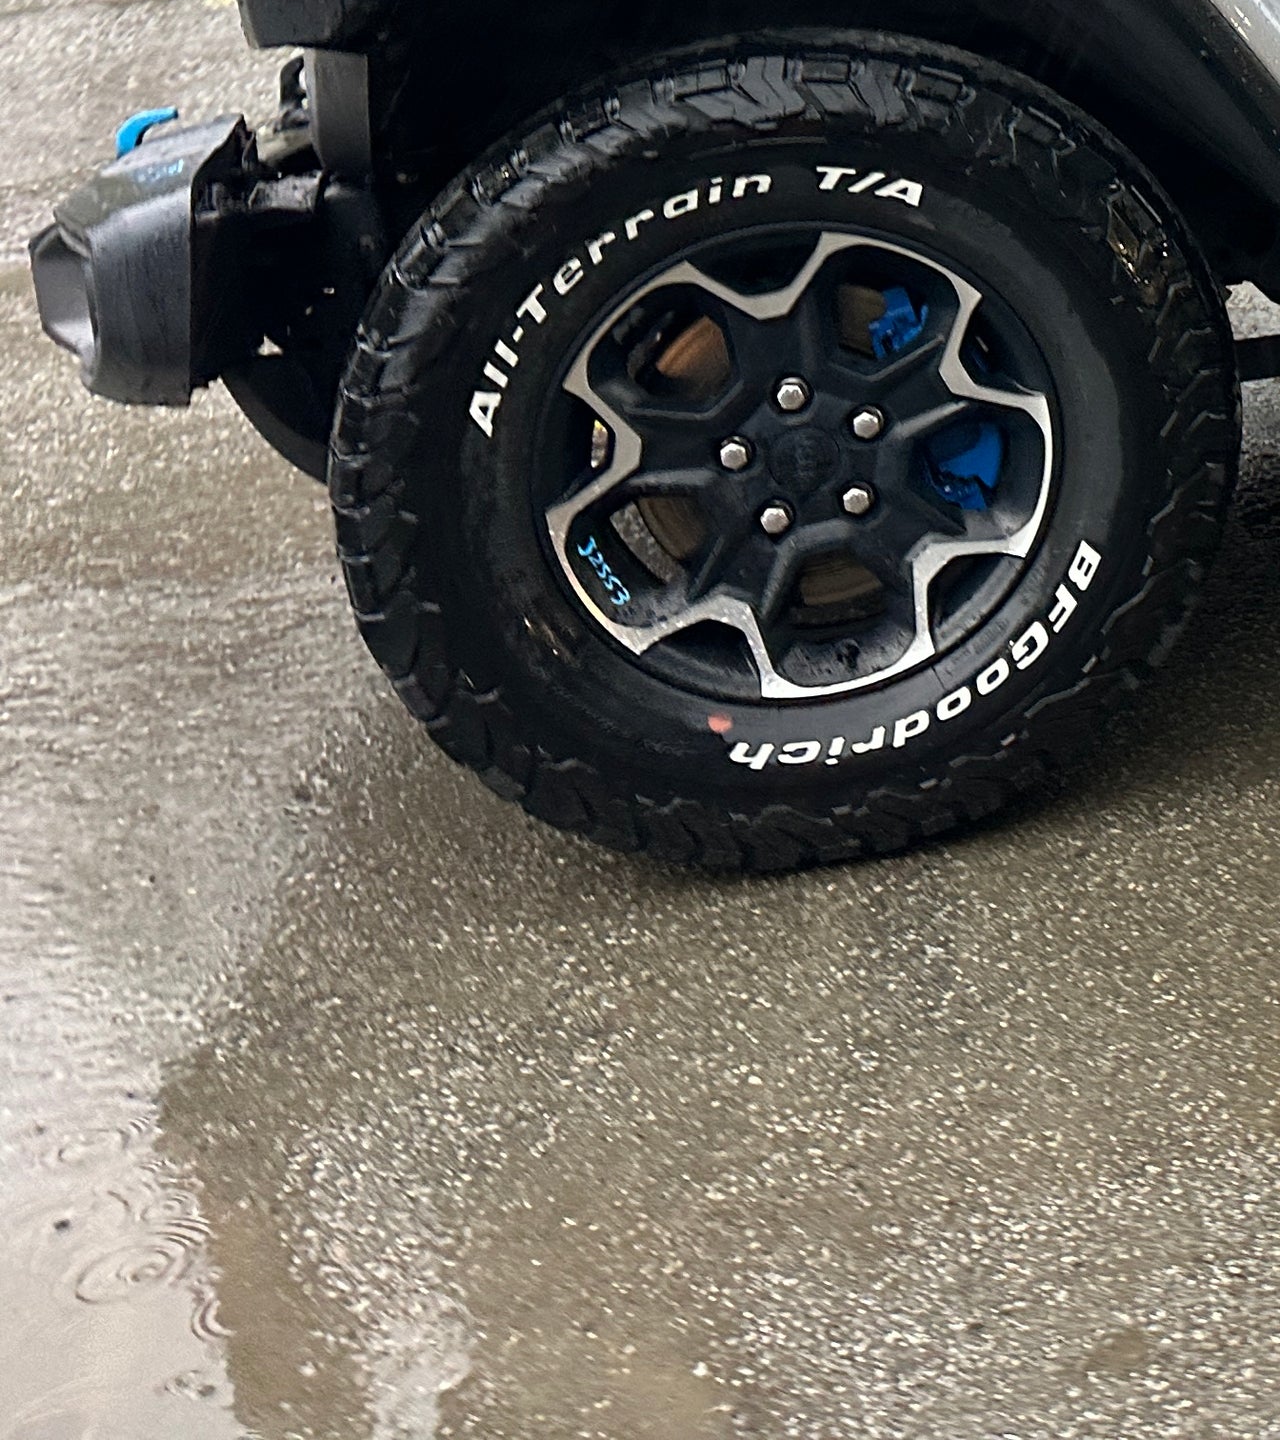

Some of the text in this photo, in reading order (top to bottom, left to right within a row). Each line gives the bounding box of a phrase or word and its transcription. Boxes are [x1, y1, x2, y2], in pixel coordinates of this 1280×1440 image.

[468, 165, 924, 438] All-Terrain T/A
[576, 535, 631, 606] J2553
[729, 539, 1102, 770] BFGoodrich
